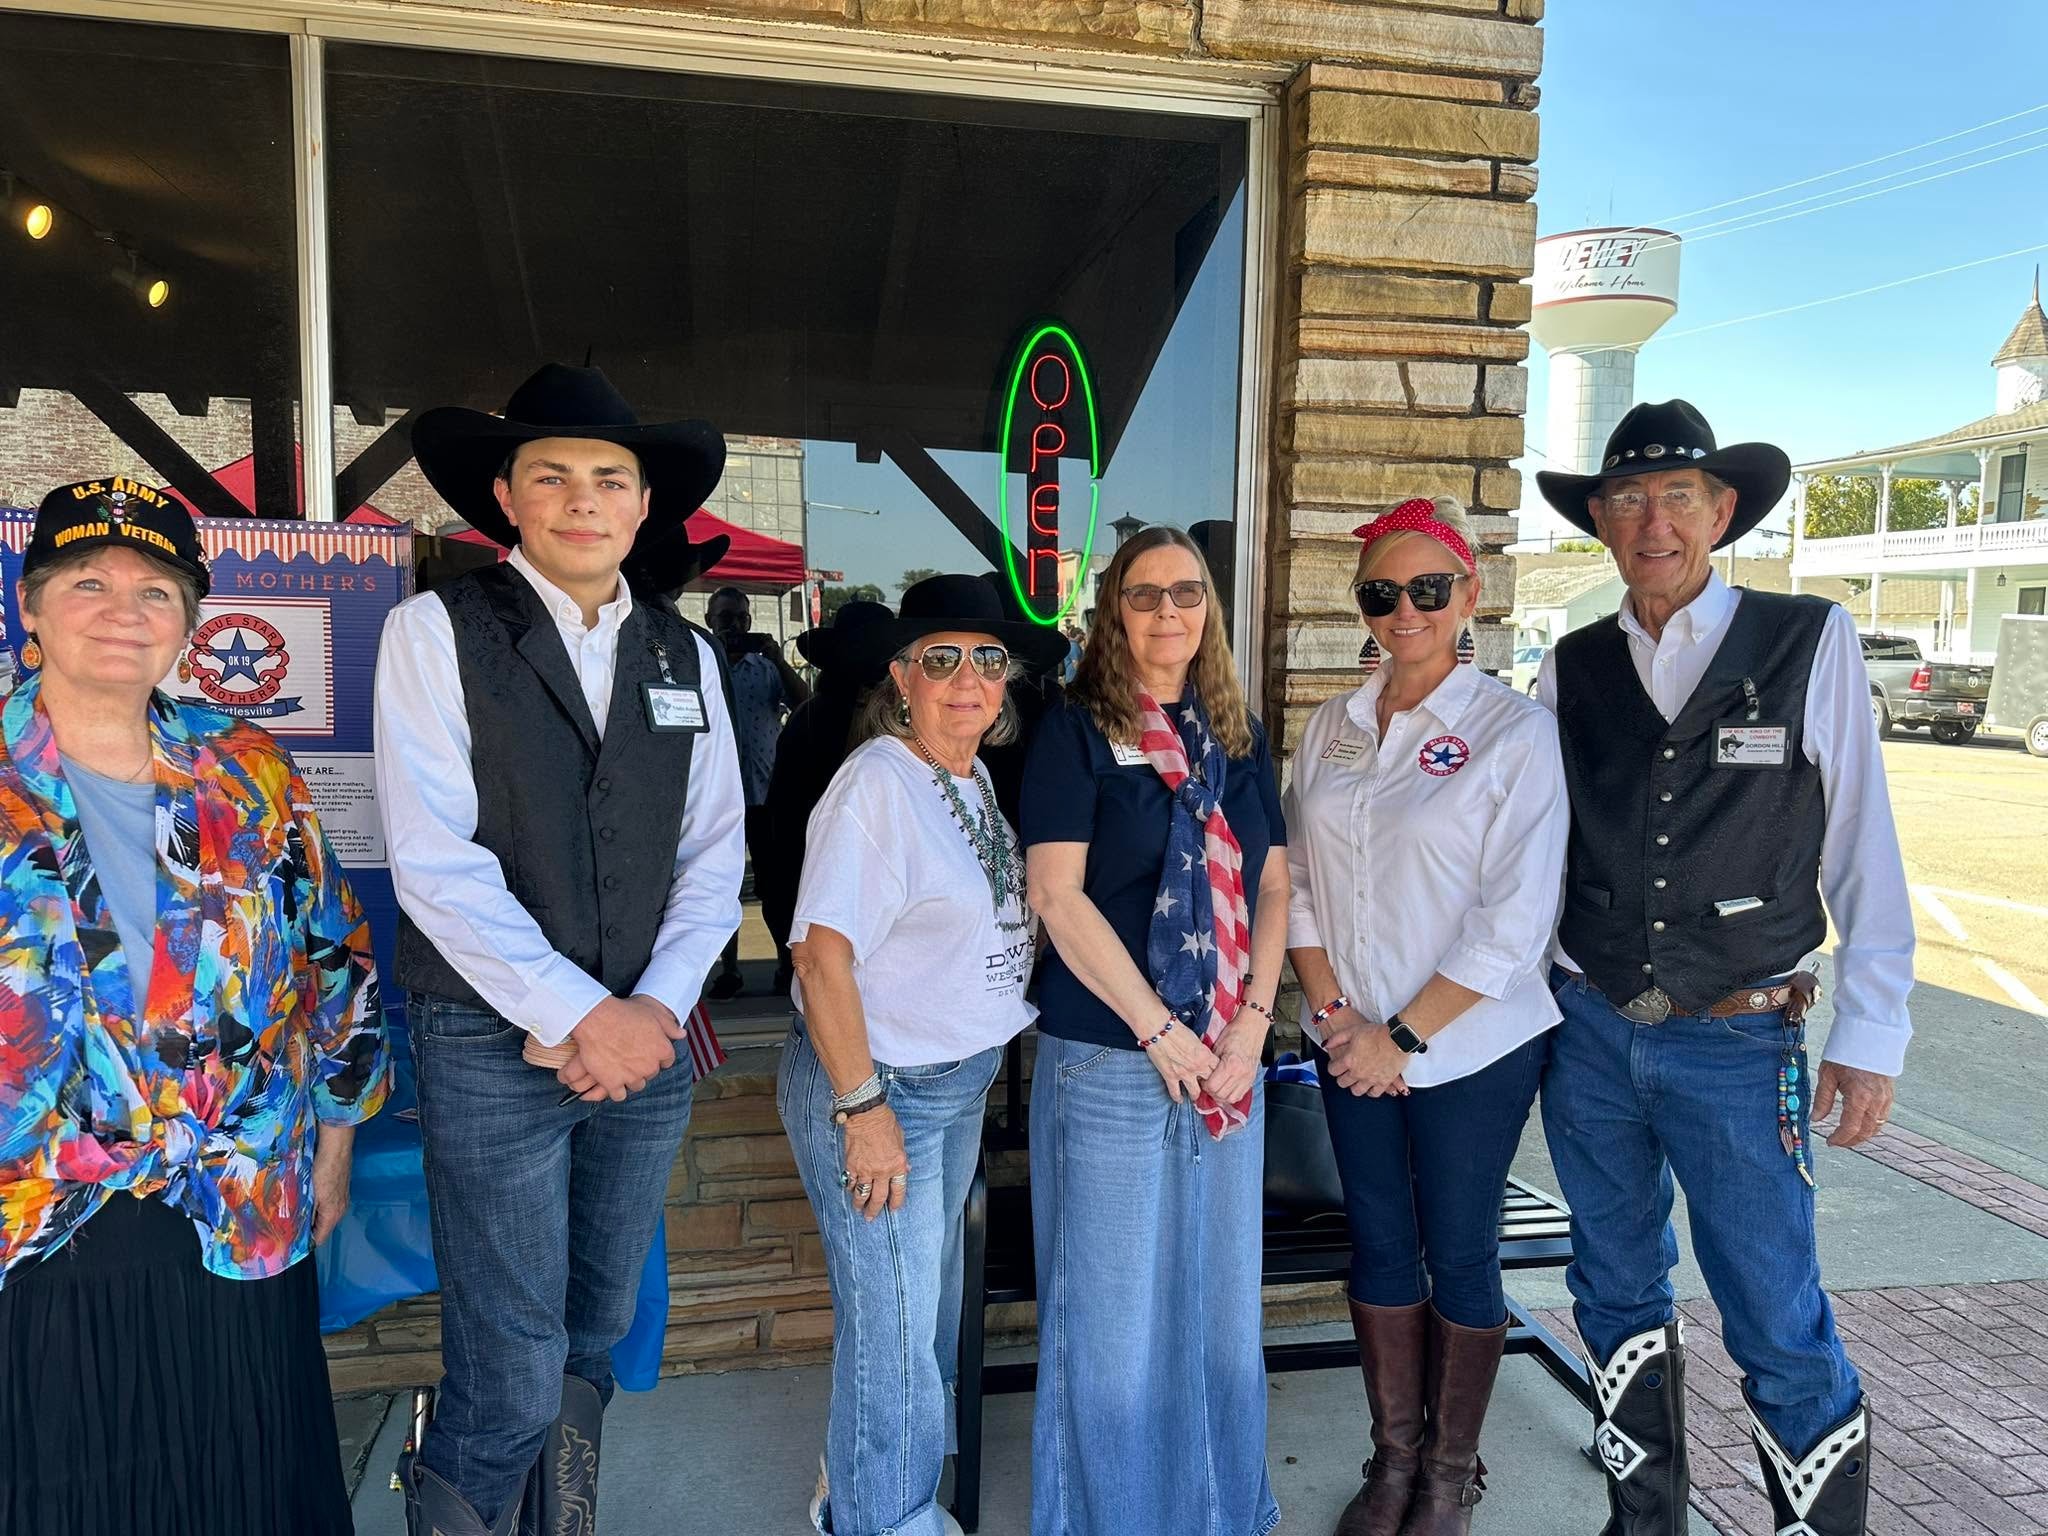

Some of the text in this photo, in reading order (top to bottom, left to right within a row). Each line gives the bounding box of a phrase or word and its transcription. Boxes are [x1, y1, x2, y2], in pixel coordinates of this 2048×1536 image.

[1555, 238, 1648, 271] DEWEY
[1610, 274, 1645, 290] Home
[72, 474, 170, 509] U.S. ARMY
[54, 522, 177, 557] WOMAN VETERAN
[237, 572, 377, 592] MOTHER'S
[200, 617, 278, 641] BLUE STAR
[228, 655, 250, 666] OK 19
[205, 683, 276, 703] MOTHERS
